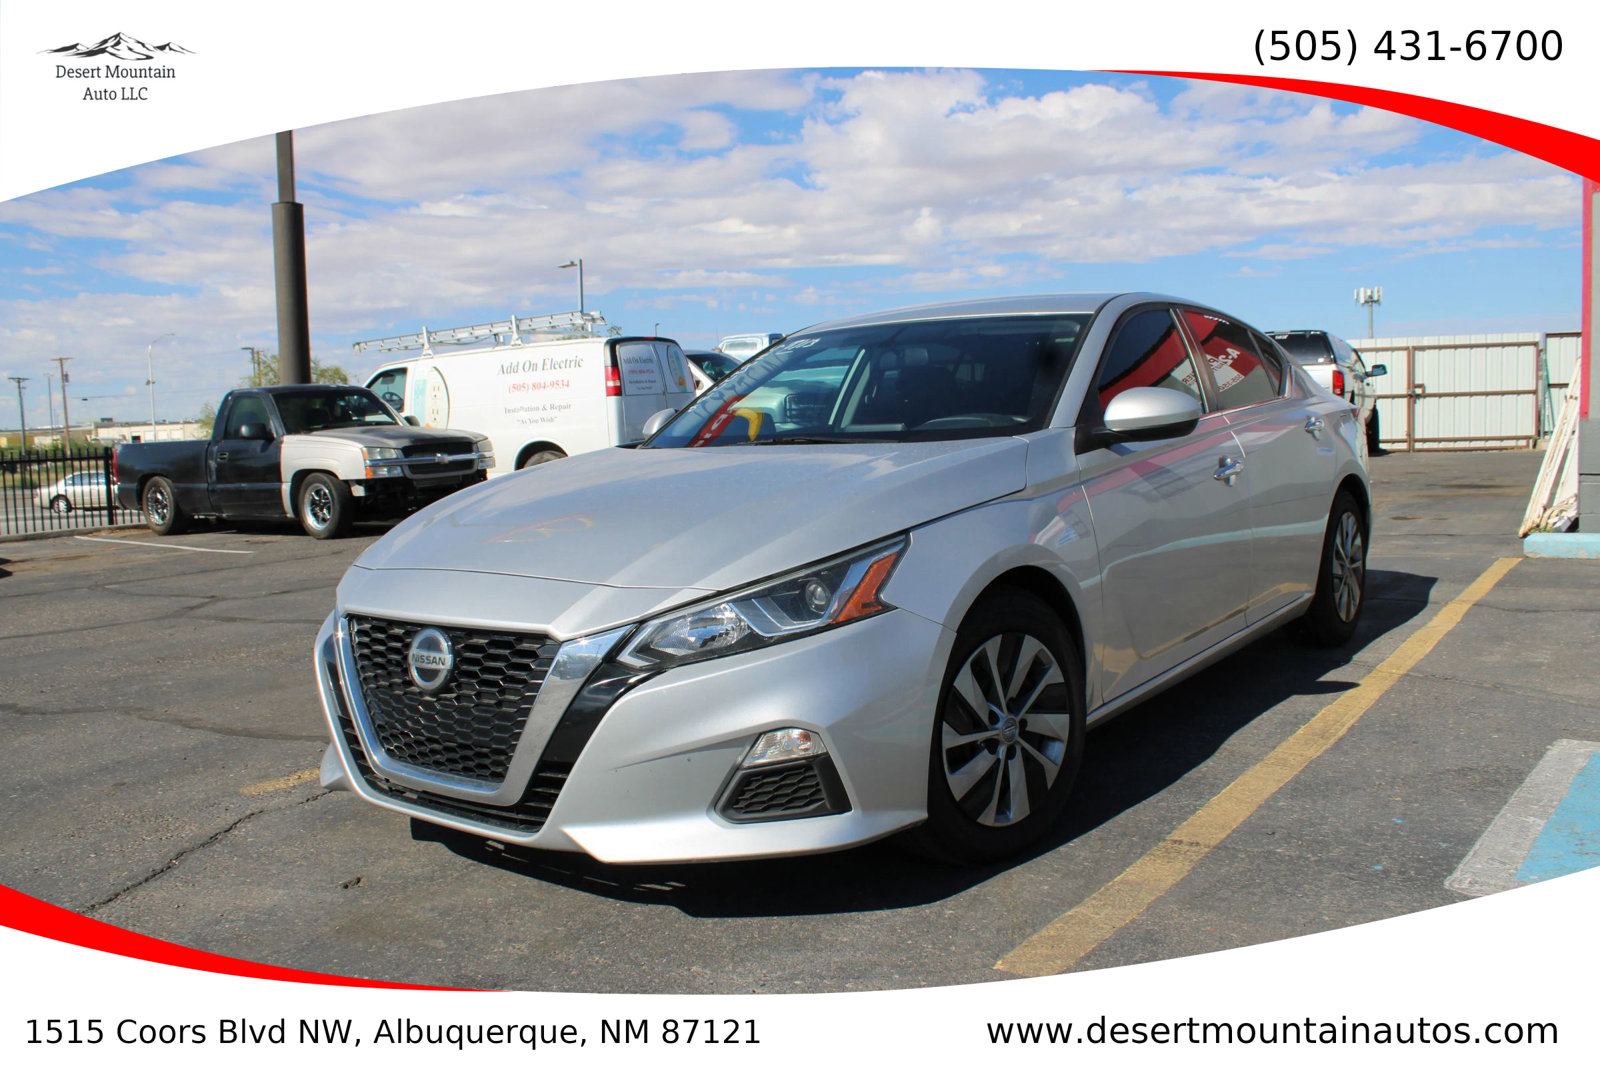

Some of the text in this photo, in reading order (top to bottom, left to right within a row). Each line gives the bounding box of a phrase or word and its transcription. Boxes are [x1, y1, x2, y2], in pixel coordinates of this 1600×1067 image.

[497, 355, 584, 376] Add On Electric
[508, 379, 570, 394] (505) 804-9534
[549, 402, 572, 413] Repair
[412, 652, 446, 667] NISSAN
